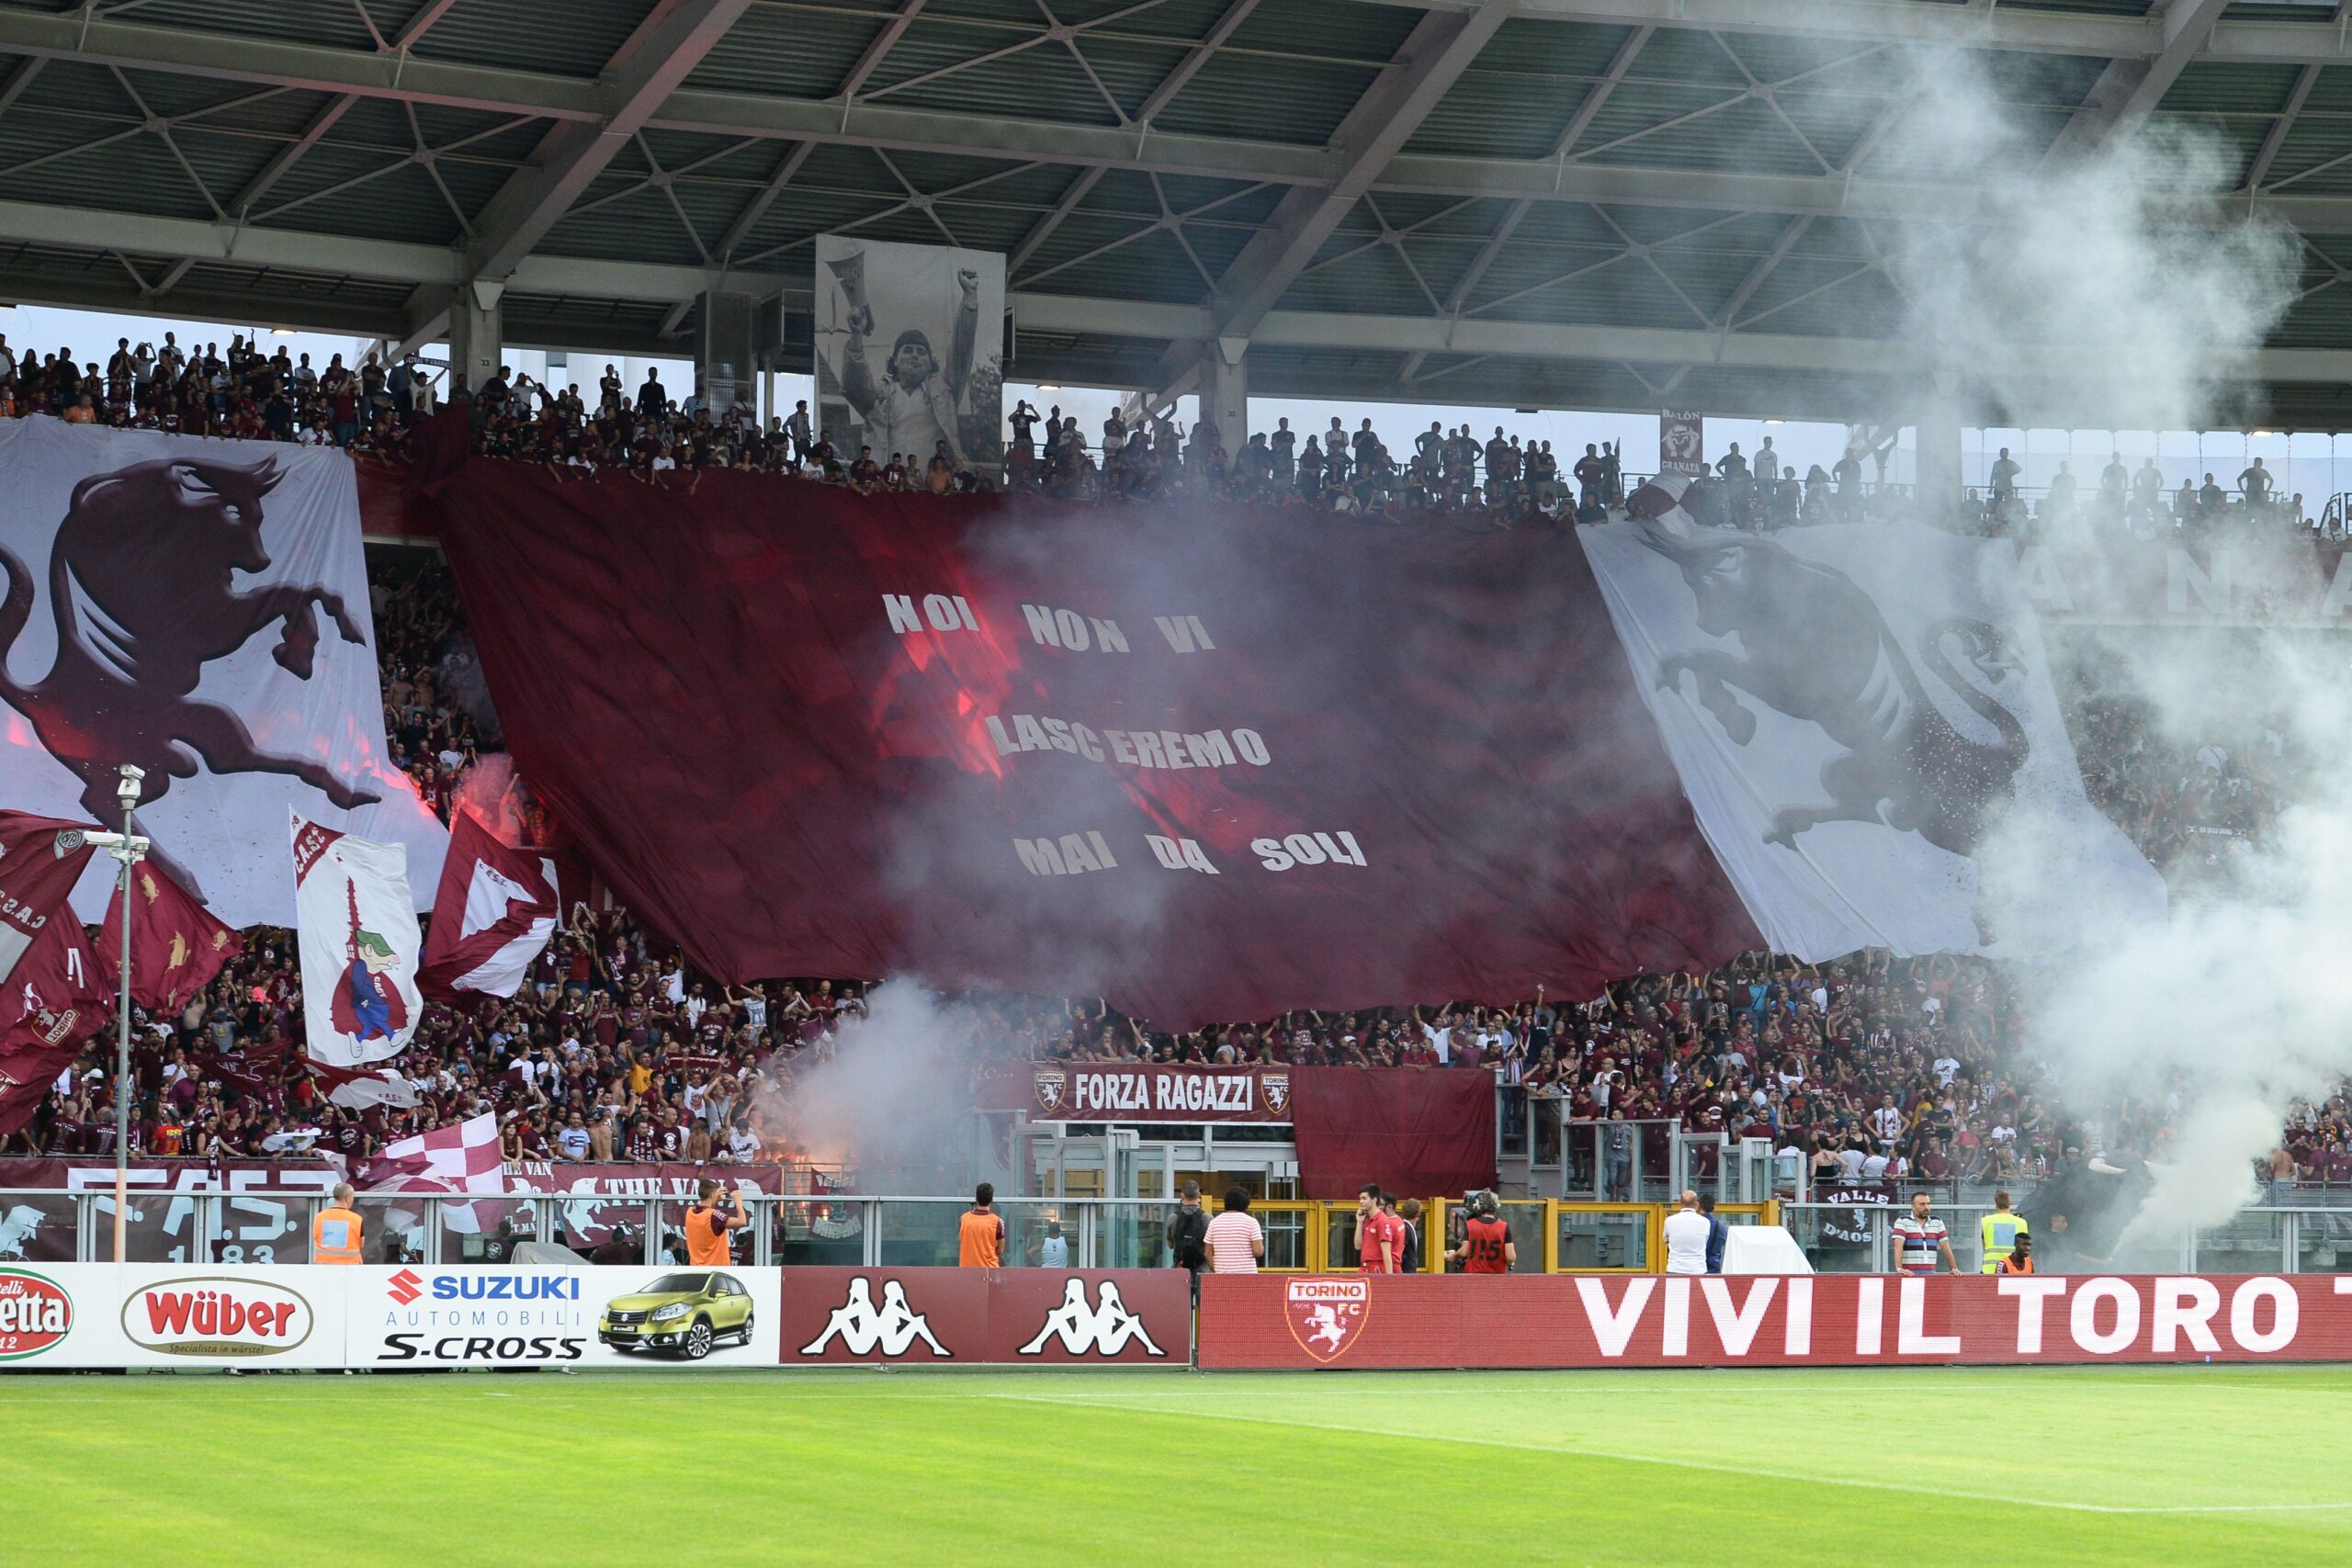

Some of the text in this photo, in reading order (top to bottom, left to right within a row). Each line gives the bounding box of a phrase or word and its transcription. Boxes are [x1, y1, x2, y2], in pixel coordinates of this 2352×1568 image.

[882, 593, 1216, 653] NOI NON VI
[1013, 830, 1368, 874] MAI DA SOLI
[1076, 1074, 1252, 1111] FORZA RAGAZZI
[605, 1178, 662, 1207] THE
[1826, 1190, 1890, 1205] VALLE
[1823, 1222, 1873, 1243] D'AOS
[0, 1280, 25, 1295] elli
[433, 1276, 579, 1300] SUZUKI
[1295, 1285, 1362, 1297] TORINO
[145, 1290, 296, 1337] Wüber
[386, 1311, 580, 1326] AUTOMOBILI
[1338, 1303, 1361, 1315] FC
[1574, 1276, 2300, 1356] VIVI IL TORO
[169, 1344, 265, 1355] Specialista in würstel
[378, 1334, 587, 1359] S-CROSS
